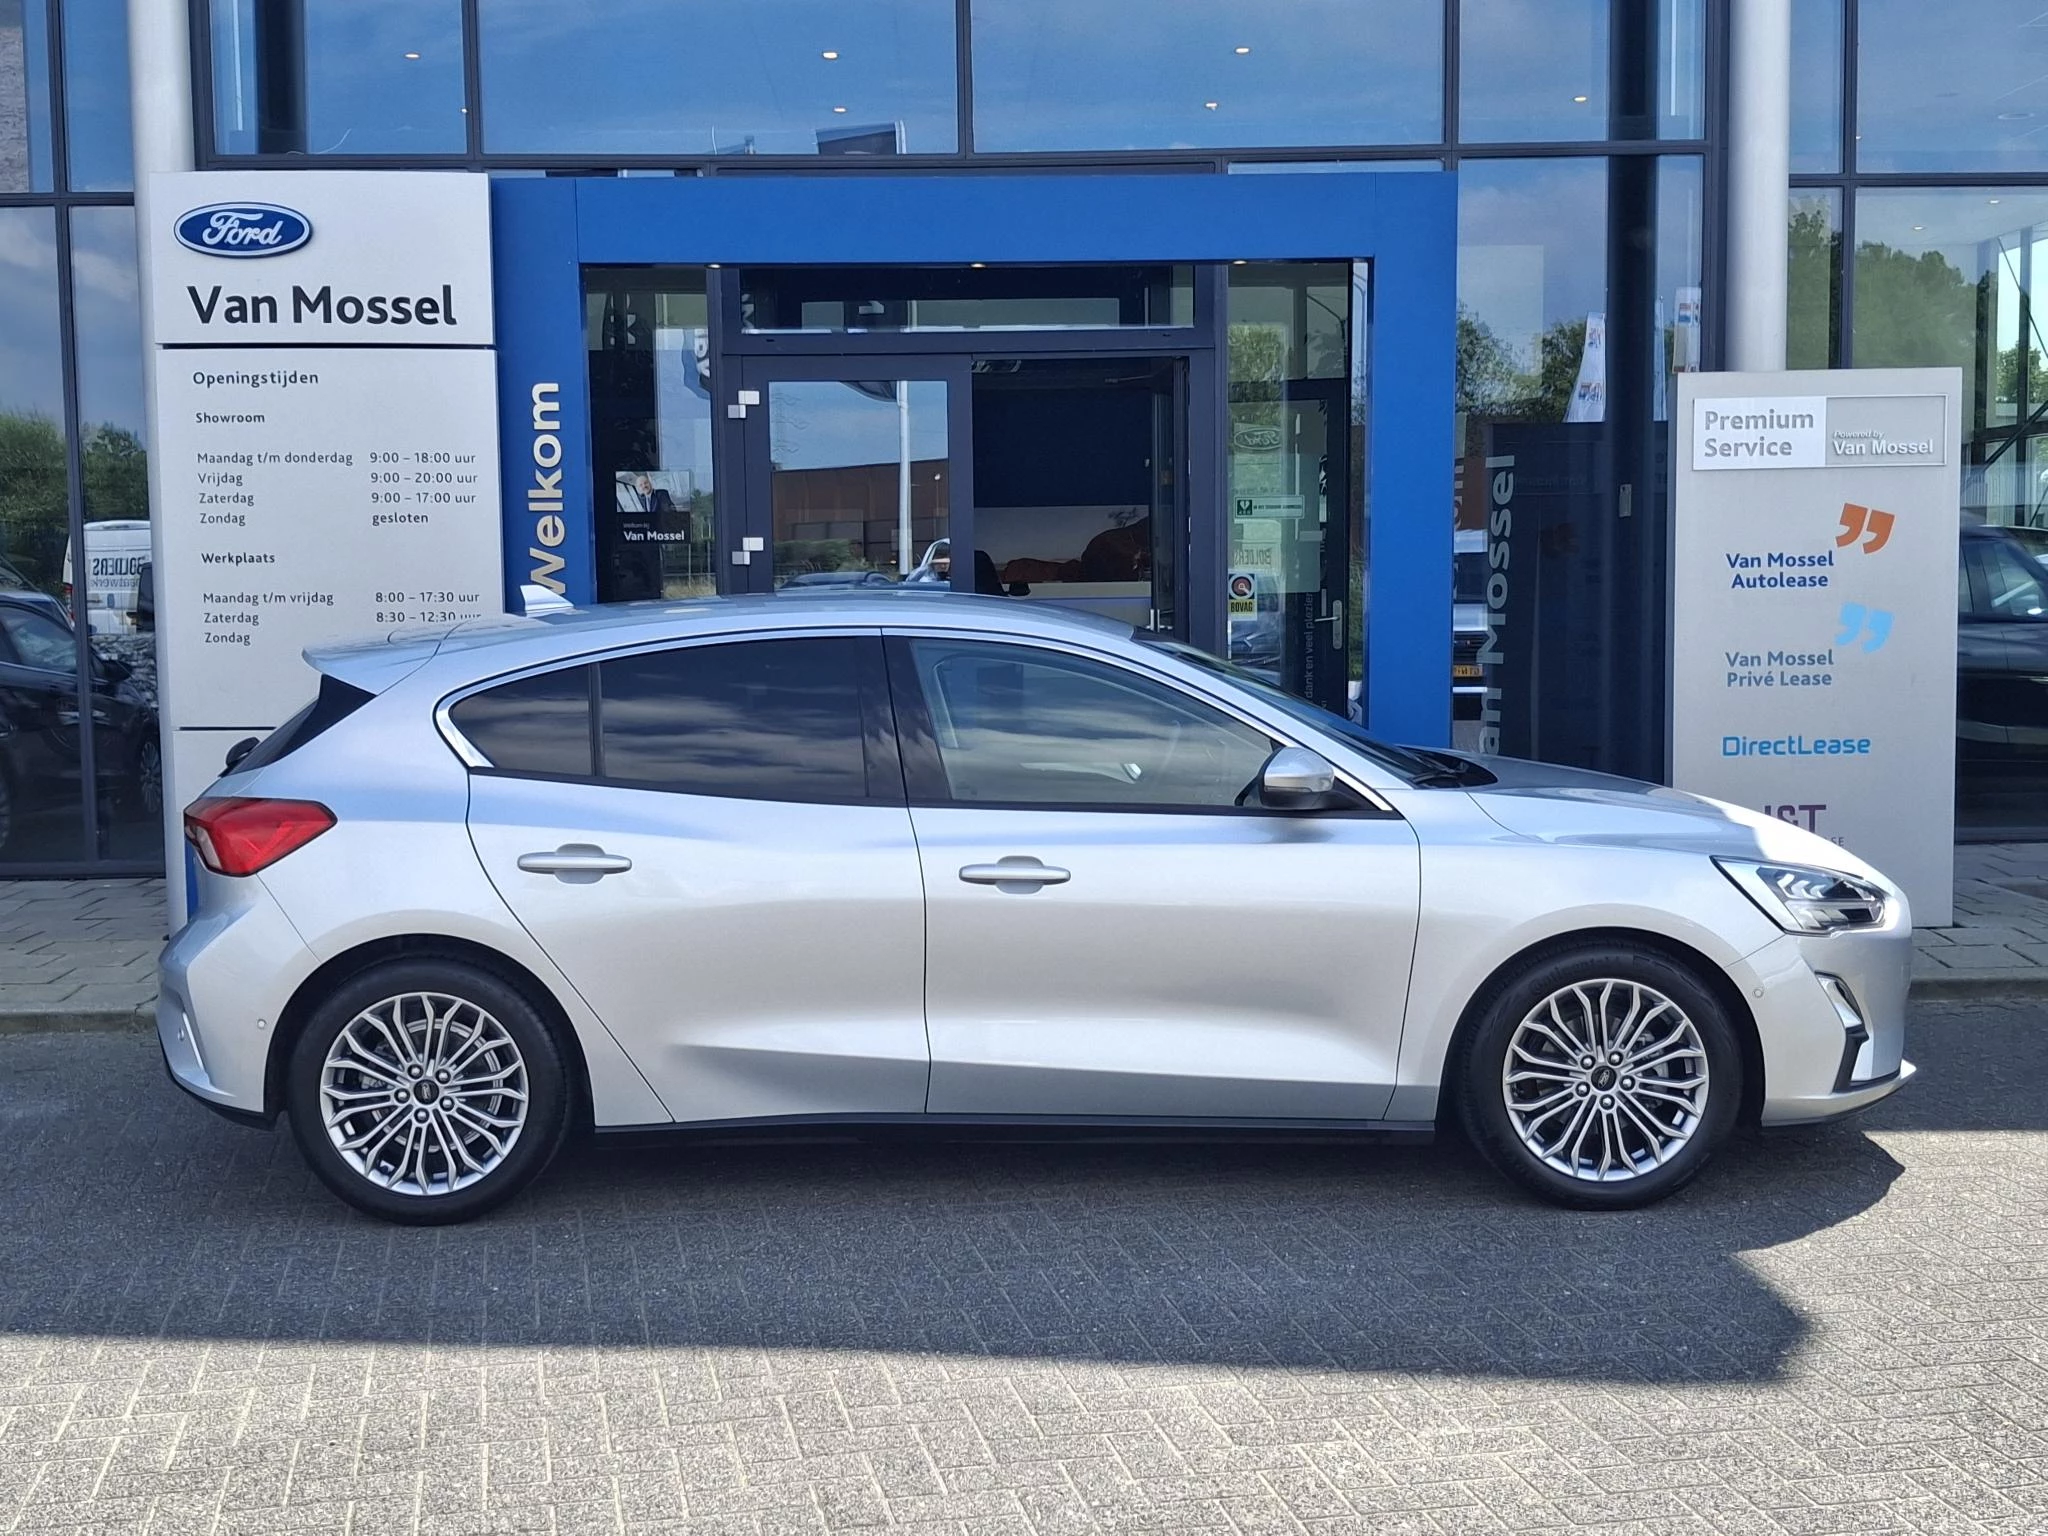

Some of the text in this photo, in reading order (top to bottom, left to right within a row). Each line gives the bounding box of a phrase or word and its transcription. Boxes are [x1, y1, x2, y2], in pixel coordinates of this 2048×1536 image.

[202, 212, 284, 246] Ford
[187, 285, 457, 325] Van Mossel
[193, 371, 318, 388] Openingstijden
[196, 413, 264, 423] Showroom
[1706, 409, 1813, 430] Premium
[1833, 430, 1885, 440] Powered by
[1705, 436, 1792, 457] Service
[1834, 440, 1934, 456] Van Mossel
[198, 452, 253, 466] Maandag
[258, 452, 280, 463] t/m
[285, 452, 352, 466] donderdag
[370, 453, 398, 463] 9:00
[415, 453, 450, 463] 18:00
[198, 473, 242, 486] Vrijdag
[371, 473, 399, 483] 9:00
[416, 473, 452, 483] 20:00
[527, 382, 566, 597] Welkom
[200, 492, 254, 506] Zaterdag
[372, 493, 400, 503] 9:00
[416, 493, 450, 503] 17:00
[201, 512, 428, 526] Zondag gesloten
[623, 529, 685, 541] Van Mossel
[202, 553, 274, 566] Werkplaats
[1726, 551, 1833, 568] Van Mossel
[1732, 572, 1828, 588] Autolease
[204, 592, 258, 606] Maandag
[263, 592, 285, 602] t/m
[290, 592, 333, 606] vrijdag
[376, 592, 404, 602] 8:00
[420, 592, 453, 602] 17:30
[1230, 601, 1253, 612] BOVAG
[1476, 455, 1515, 755] an Mossel
[204, 612, 259, 626] Zaterdag
[377, 612, 405, 622] 8:30
[421, 612, 455, 622] 12:30
[205, 632, 250, 646] Zondag
[1726, 649, 1833, 667] Van Mossel
[1728, 671, 1831, 687] Privé Lease
[1723, 736, 1870, 756] DirectLease
